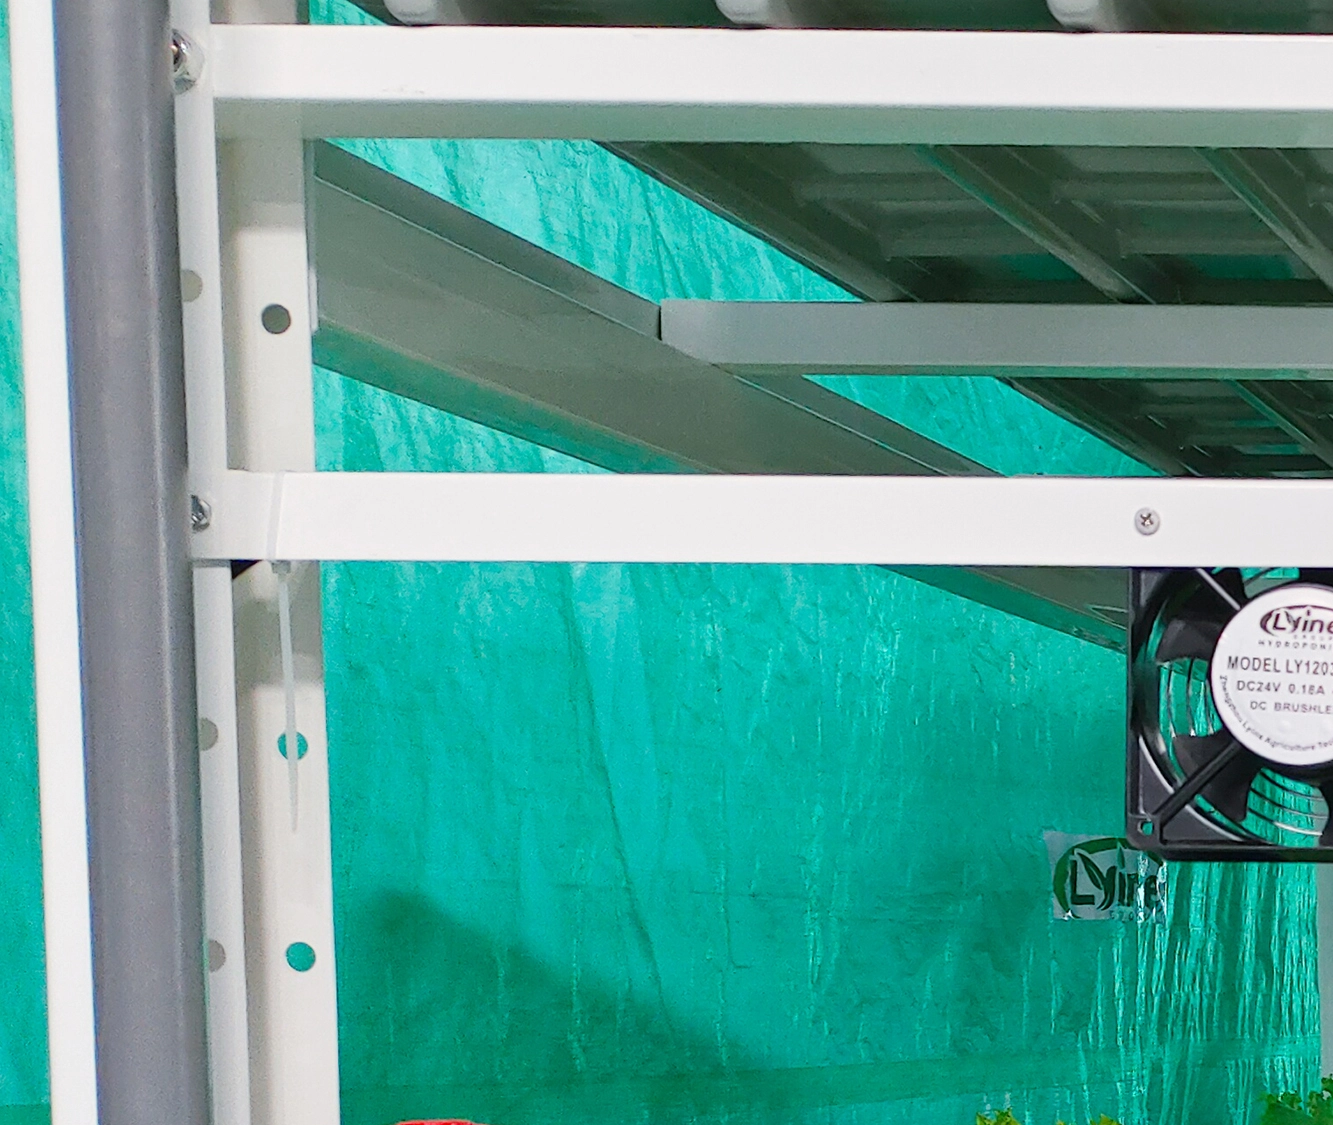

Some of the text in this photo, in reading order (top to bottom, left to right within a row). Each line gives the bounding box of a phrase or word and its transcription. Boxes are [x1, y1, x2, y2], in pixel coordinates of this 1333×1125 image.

[1227, 656, 1281, 673] MODEL
[1237, 680, 1281, 692] DC24V
[1250, 700, 1267, 711] DC
